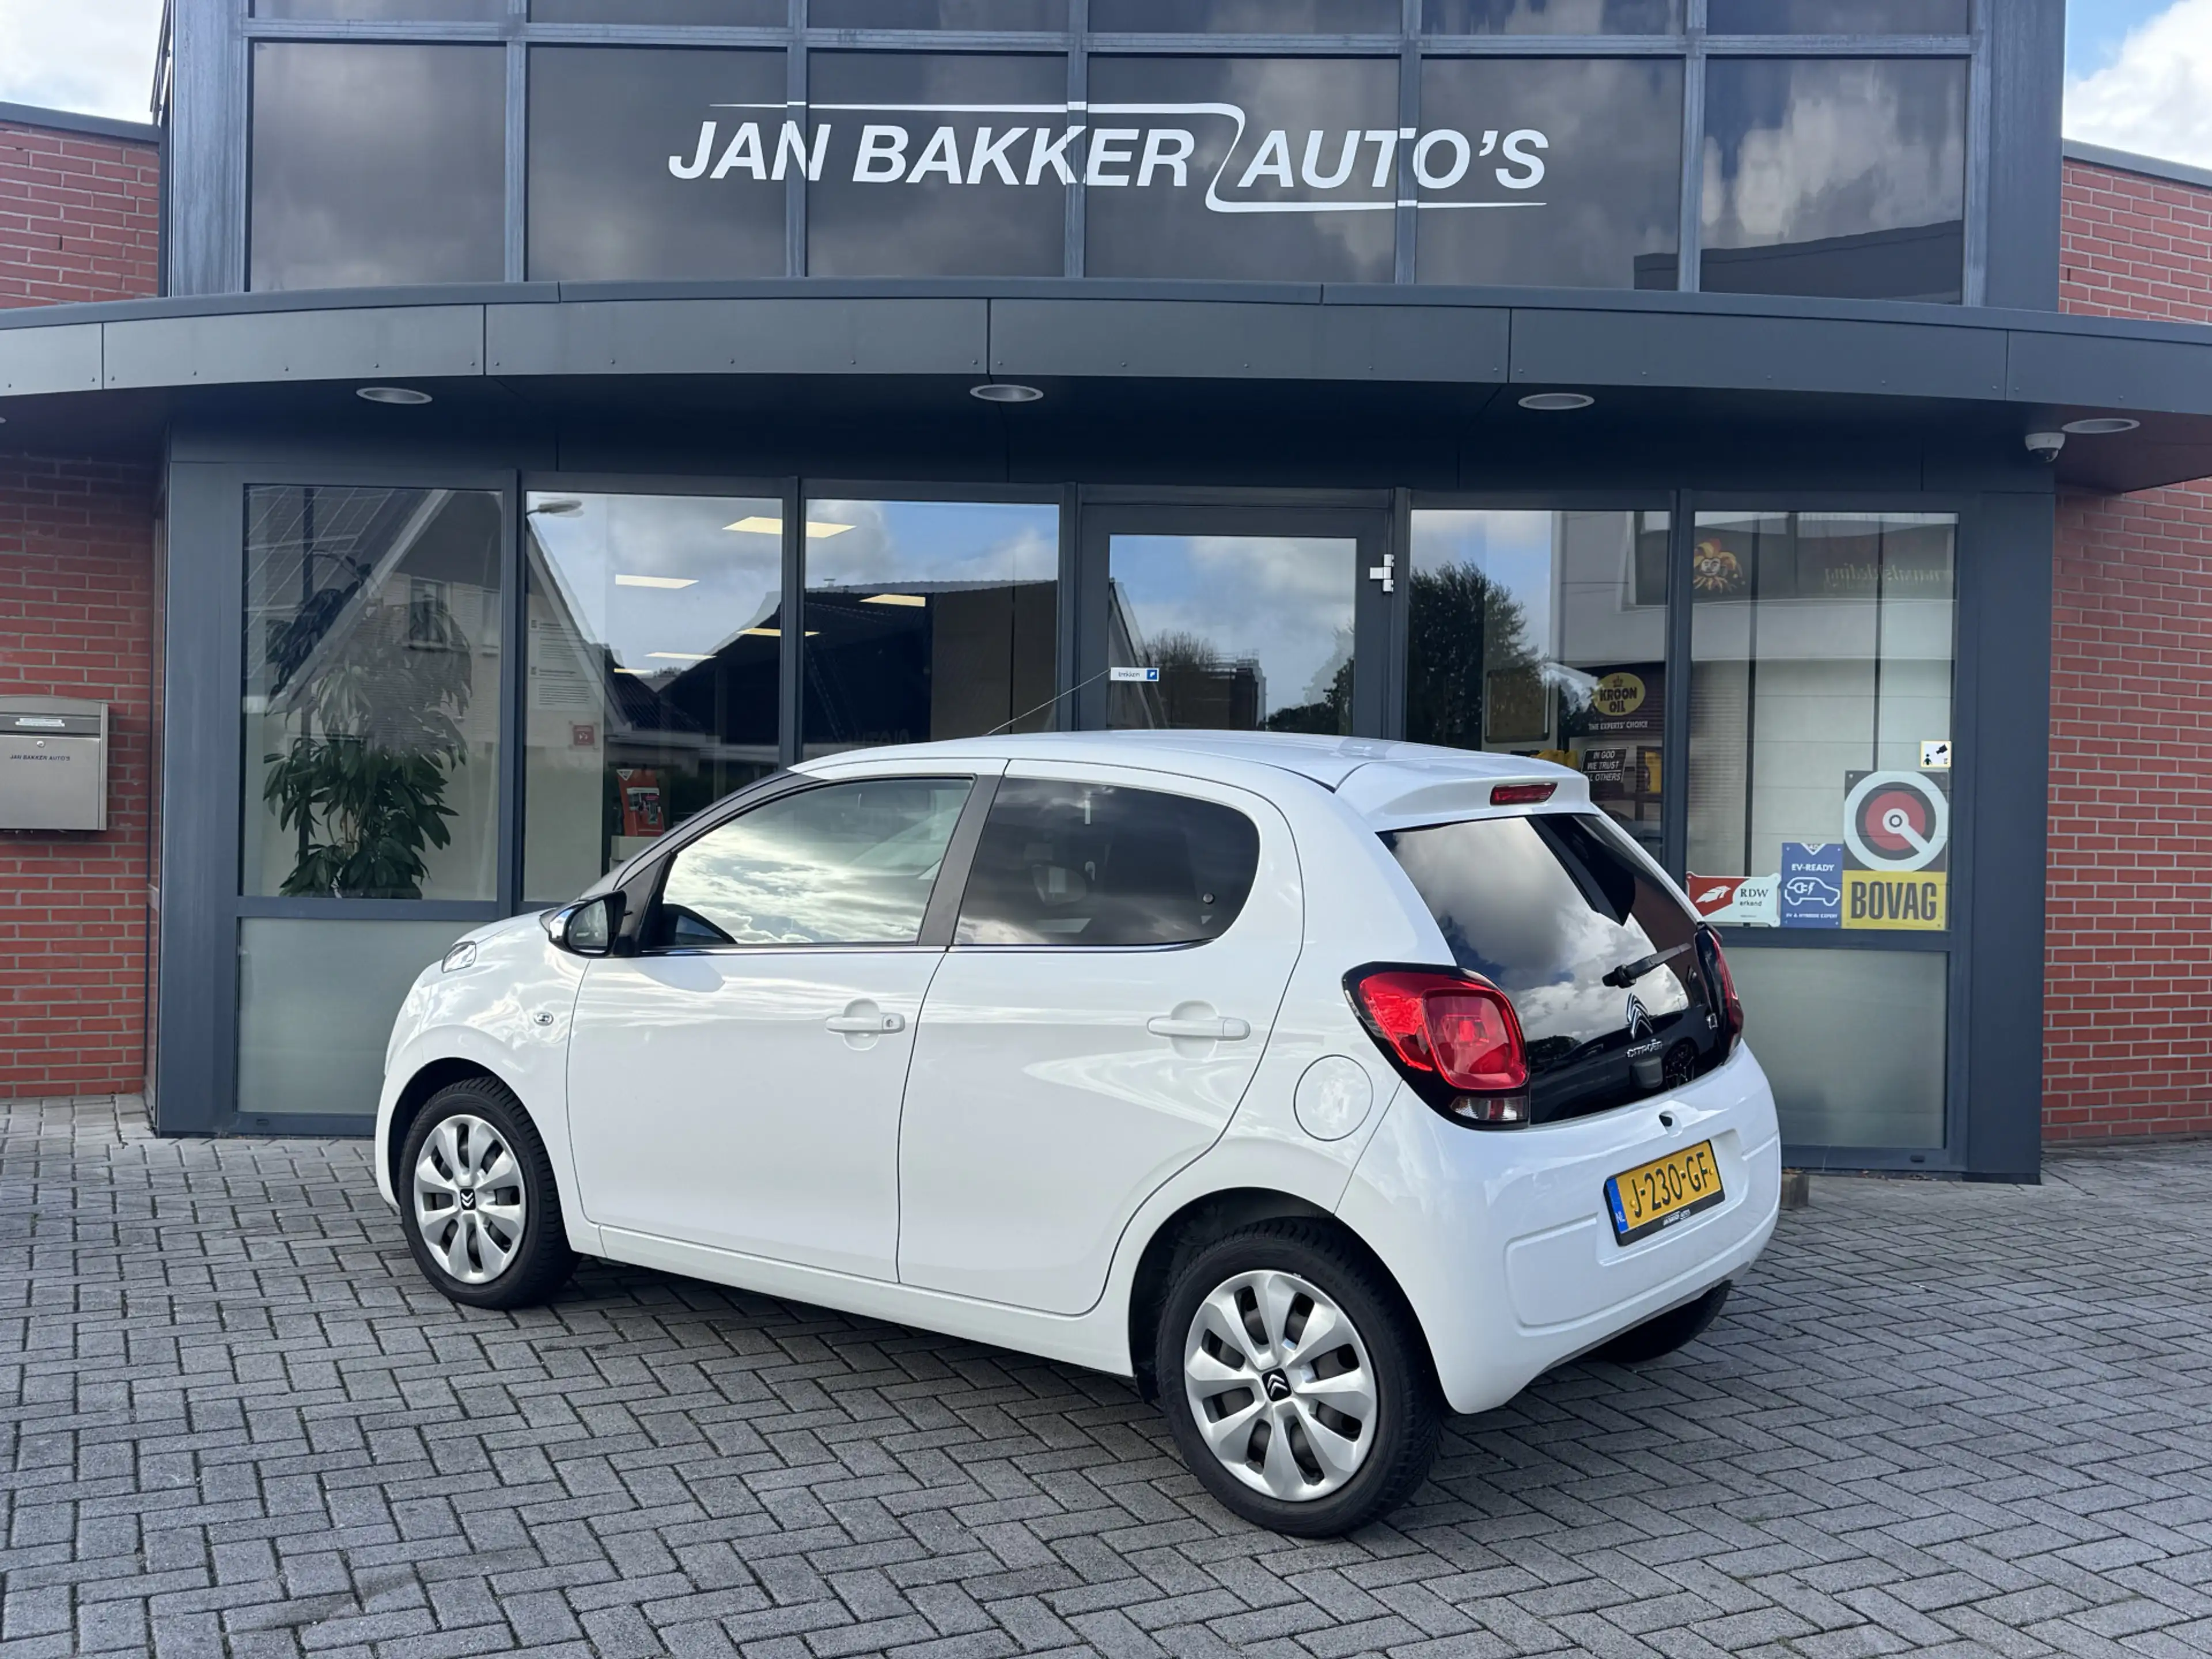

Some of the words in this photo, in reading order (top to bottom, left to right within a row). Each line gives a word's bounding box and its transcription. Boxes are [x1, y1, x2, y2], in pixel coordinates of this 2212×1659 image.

[668, 120, 831, 181] JAN
[853, 124, 1195, 185] BAKKER
[1237, 127, 1549, 189] AUTO'S
[1600, 687, 1638, 701] KROON
[1609, 700, 1626, 713] OIL
[1601, 751, 1615, 759] GOD
[1588, 762, 1597, 770] WE
[1599, 760, 1619, 770] TRUST
[1595, 773, 1621, 781] OTHERS
[1791, 863, 1835, 872] EV-READY
[1740, 888, 1768, 897] RDW
[1851, 881, 1937, 921] BOVAG
[1631, 1152, 1709, 1218] J-230-GF
